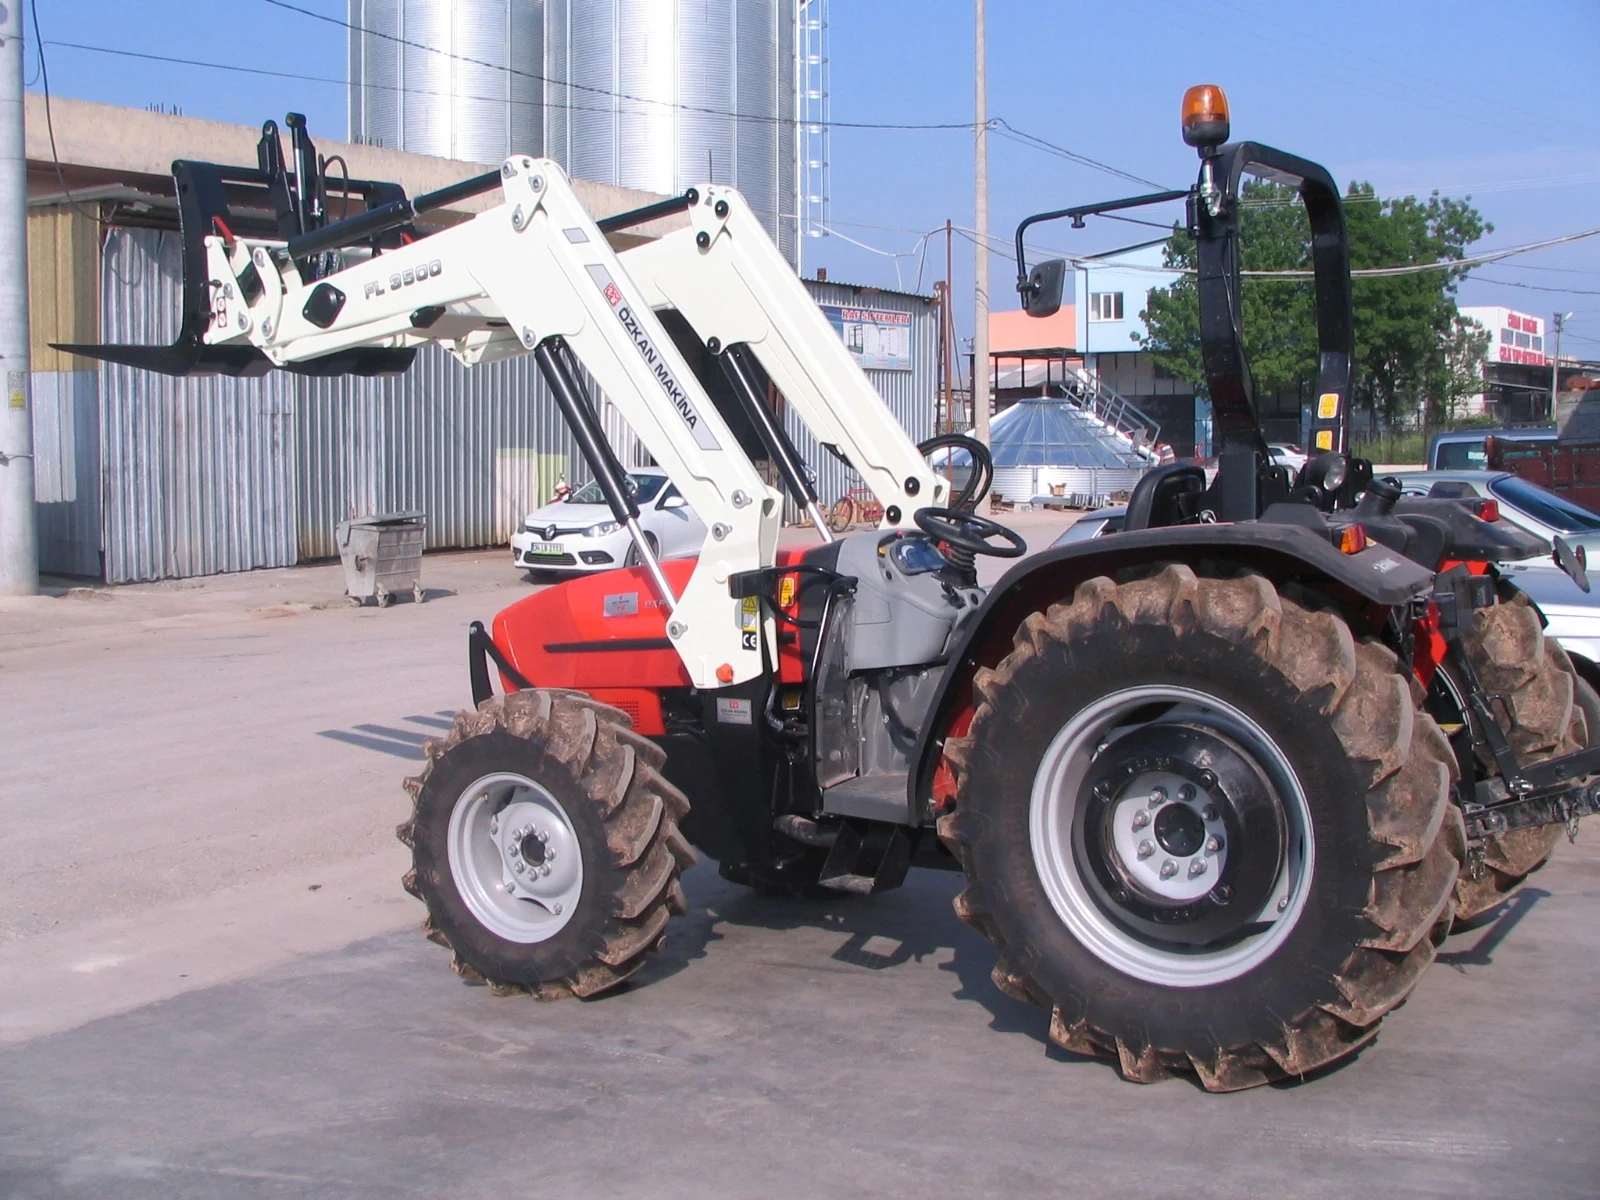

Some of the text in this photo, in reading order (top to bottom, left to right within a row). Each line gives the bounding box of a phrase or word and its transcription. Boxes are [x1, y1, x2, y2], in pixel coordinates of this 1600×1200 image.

[364, 259, 442, 300] FL 3500
[618, 306, 698, 430] ÖZKAN MAKİNA
[743, 633, 757, 648] CE
